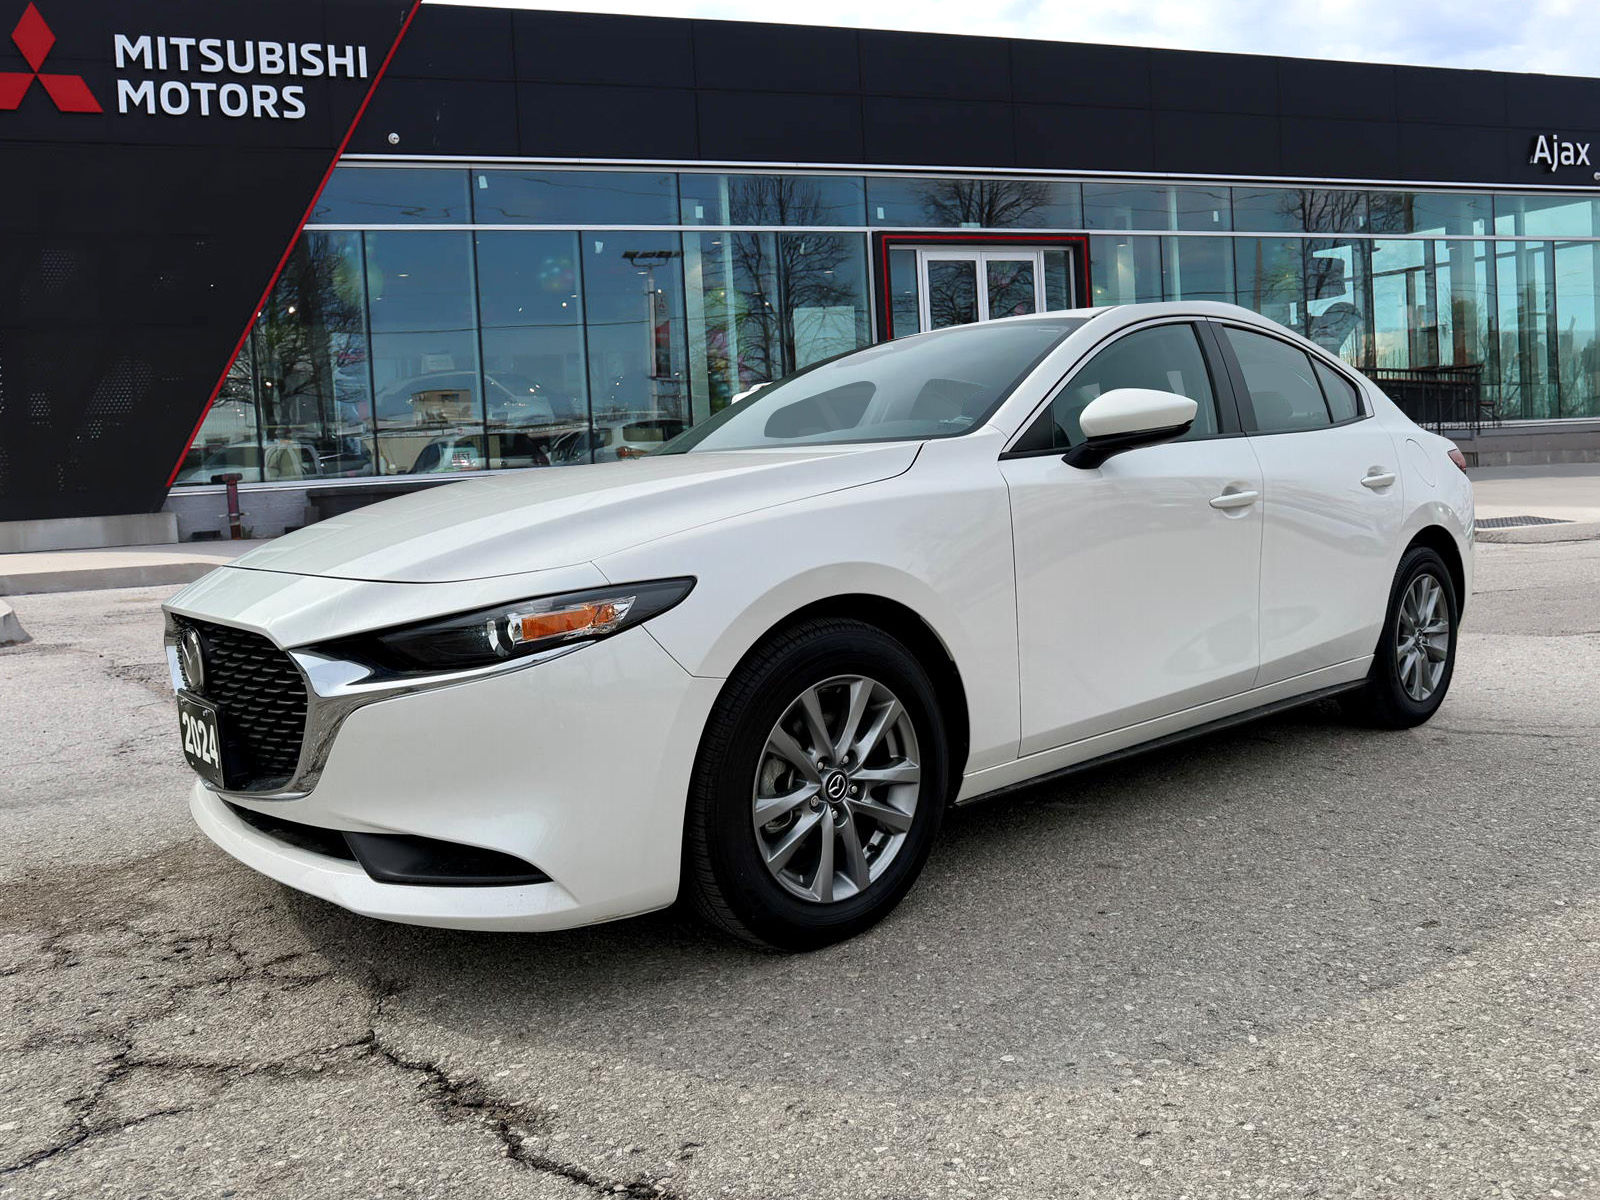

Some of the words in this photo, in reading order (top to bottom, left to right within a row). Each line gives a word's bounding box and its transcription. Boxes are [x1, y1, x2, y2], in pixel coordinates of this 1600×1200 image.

[114, 34, 368, 78] MITSUBISHI
[117, 79, 306, 119] MOTORS
[1533, 134, 1591, 173] Ajax
[182, 711, 219, 769] 2024
